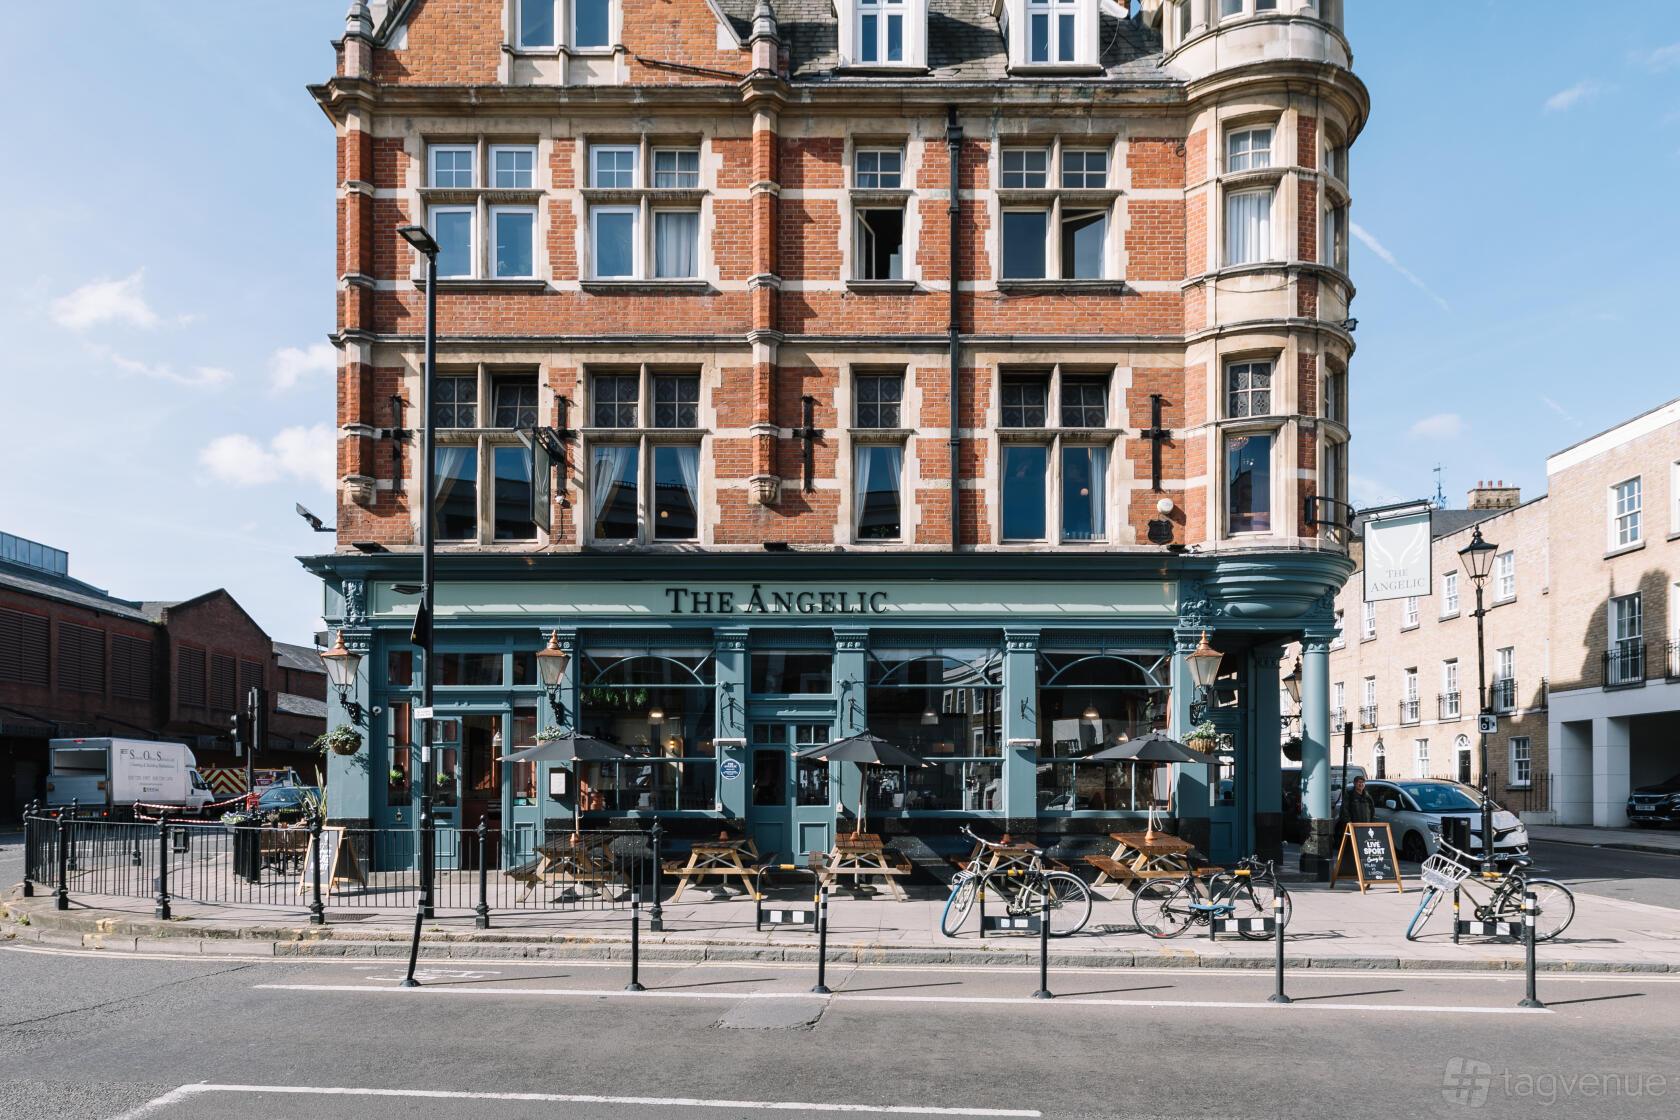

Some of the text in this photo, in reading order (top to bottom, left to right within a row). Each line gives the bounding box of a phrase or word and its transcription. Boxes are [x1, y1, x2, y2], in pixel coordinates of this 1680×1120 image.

[1385, 567, 1408, 578] THE
[1370, 577, 1425, 593] ANGELIC
[665, 587, 734, 613] THE
[1363, 847, 1385, 855] SPORT
